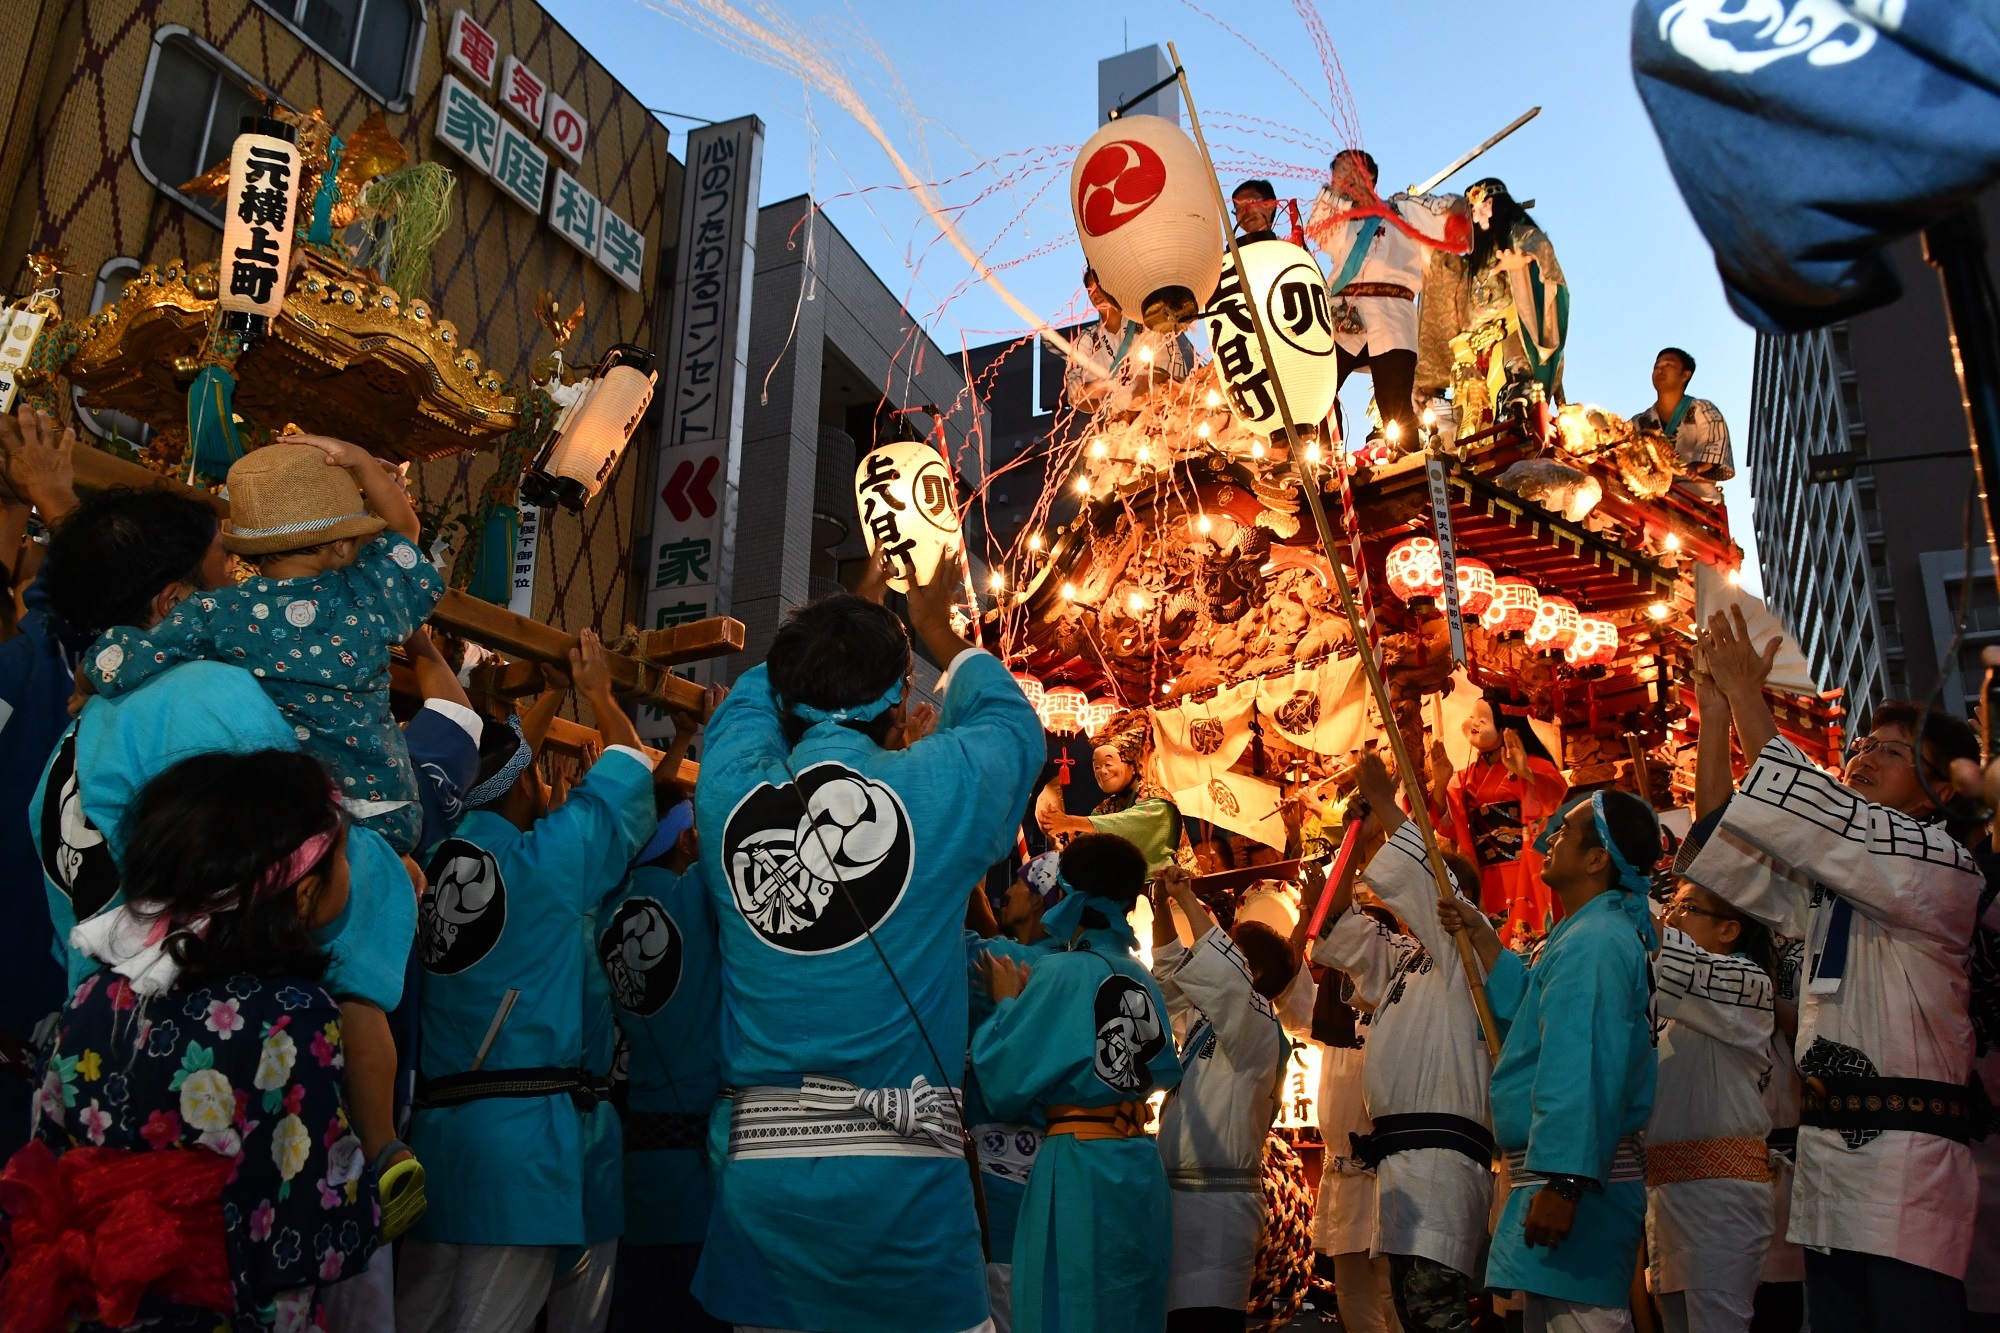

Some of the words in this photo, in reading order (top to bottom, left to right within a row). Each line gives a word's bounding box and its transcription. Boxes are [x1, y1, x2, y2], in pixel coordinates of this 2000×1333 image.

[460, 16, 583, 152] 電気の
[230, 145, 291, 304] 元横上町
[444, 85, 641, 276] 家庭科学
[679, 135, 732, 444] 心のつたわるコンセント
[859, 454, 917, 580] 上八日町
[1443, 550, 1460, 631] 天皇陛下御即位
